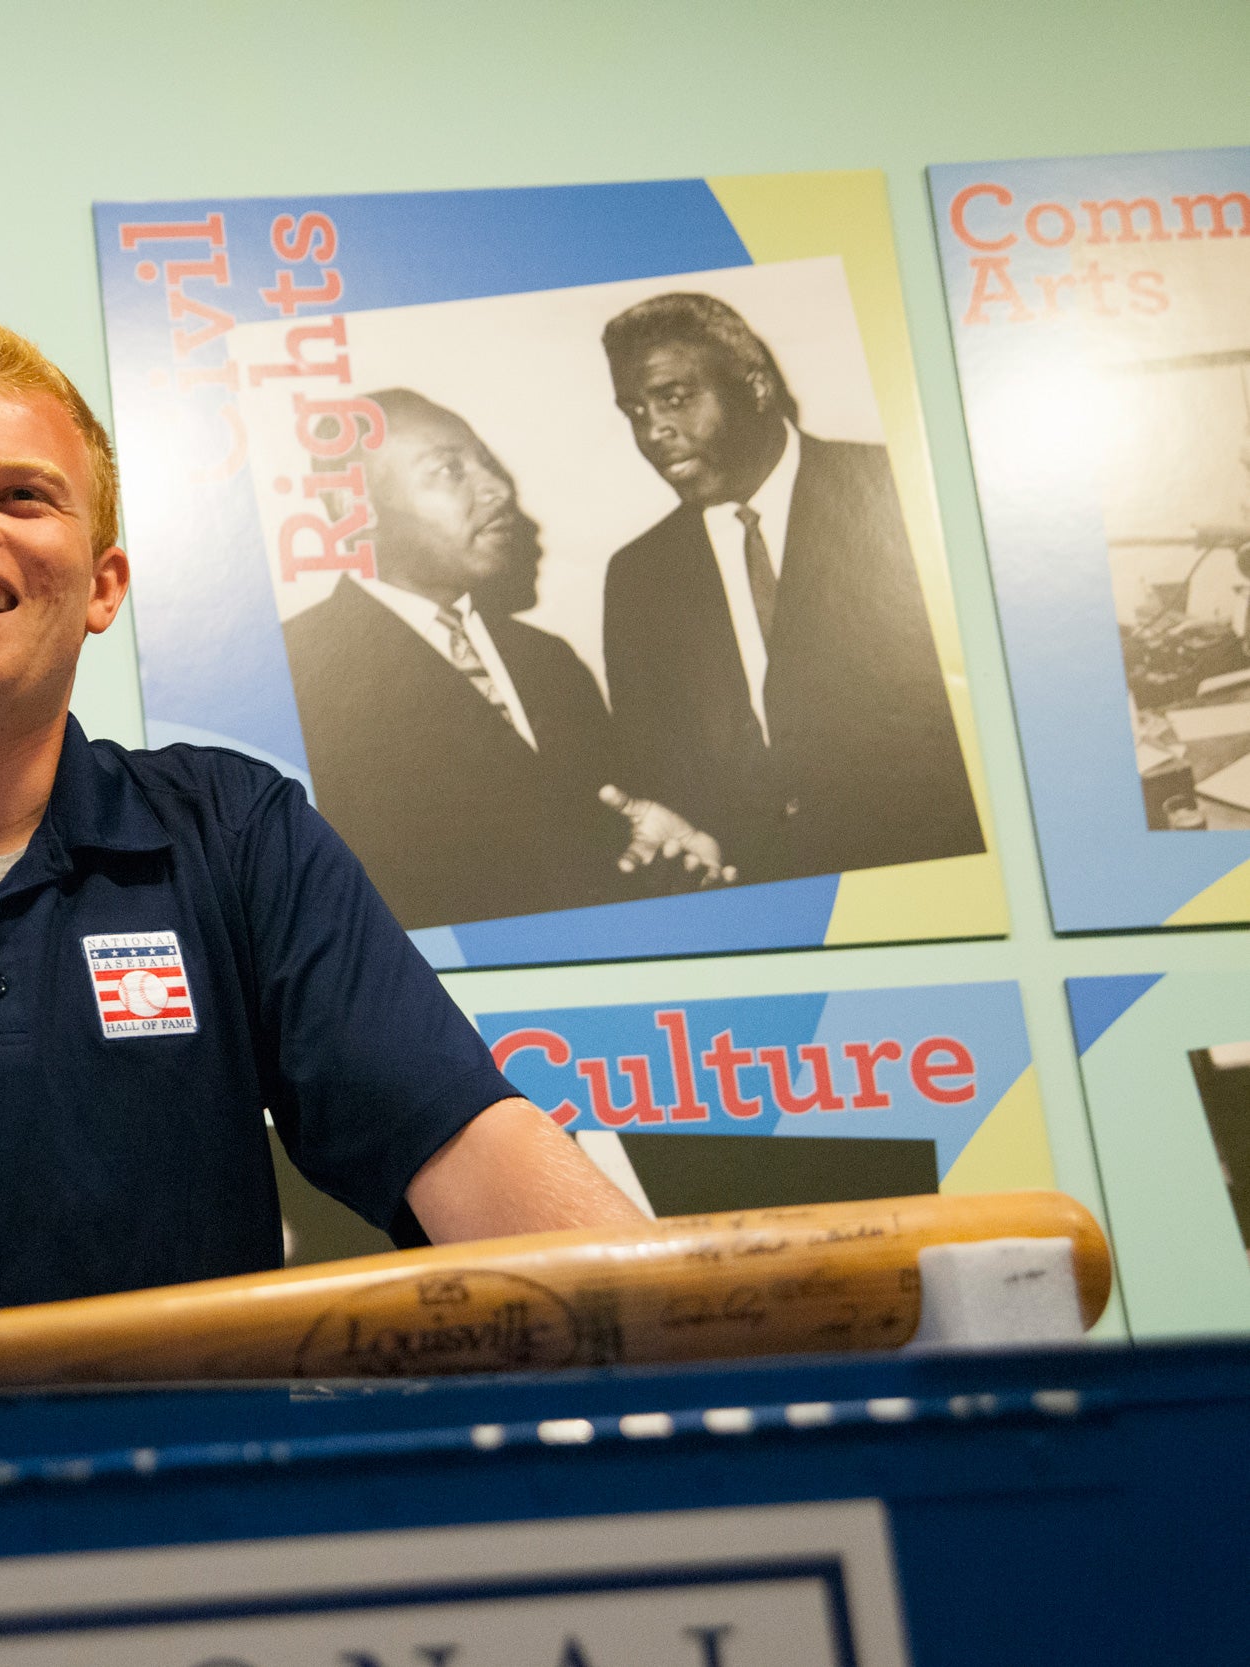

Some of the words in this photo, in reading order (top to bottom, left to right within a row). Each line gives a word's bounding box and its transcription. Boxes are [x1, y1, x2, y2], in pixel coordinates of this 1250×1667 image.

[962, 255, 1171, 326] Arts
[120, 212, 247, 483] Civil
[249, 210, 386, 583] Rights
[87, 935, 176, 949] NATIONAL
[92, 956, 181, 970] BASEBALL
[106, 1021, 140, 1034] HALL
[142, 1020, 158, 1031] OF
[161, 1018, 194, 1030] FAME
[490, 1009, 977, 1128] Culture
